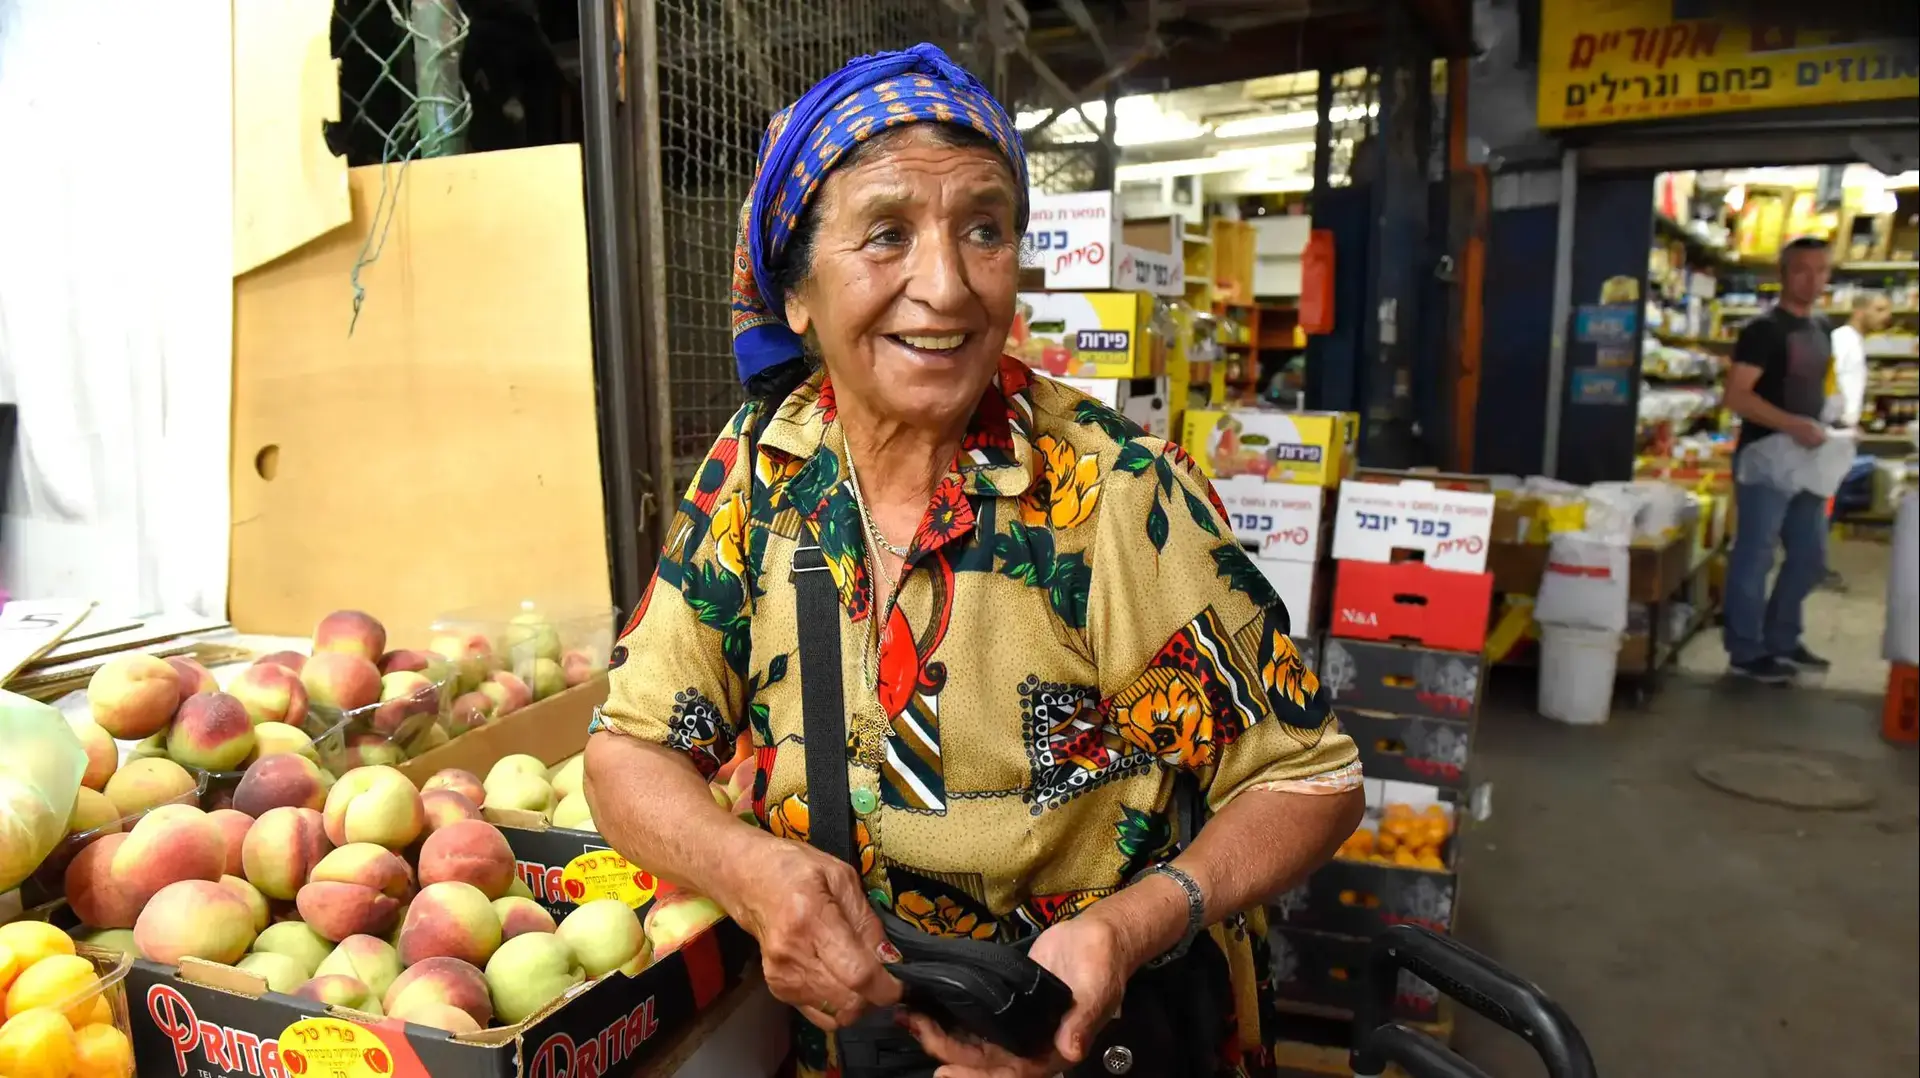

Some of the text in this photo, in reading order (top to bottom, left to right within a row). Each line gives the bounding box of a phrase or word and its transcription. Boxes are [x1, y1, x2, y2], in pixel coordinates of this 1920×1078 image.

[1567, 72, 1679, 107] וגרילים
[1699, 66, 1771, 93] פחם
[1052, 242, 1105, 275] פירות
[1079, 331, 1128, 349] פירות
[1278, 444, 1321, 462] פירות
[1231, 512, 1274, 531] כפר
[1355, 511, 1452, 538] כפר יובל
[1264, 526, 1309, 549] פירות
[1433, 535, 1484, 559] פירות
[1341, 608, 1378, 627] N&A
[575, 856, 627, 873] פרי טל
[147, 983, 293, 1078] PRITA
[291, 1025, 355, 1044] פרי טל
